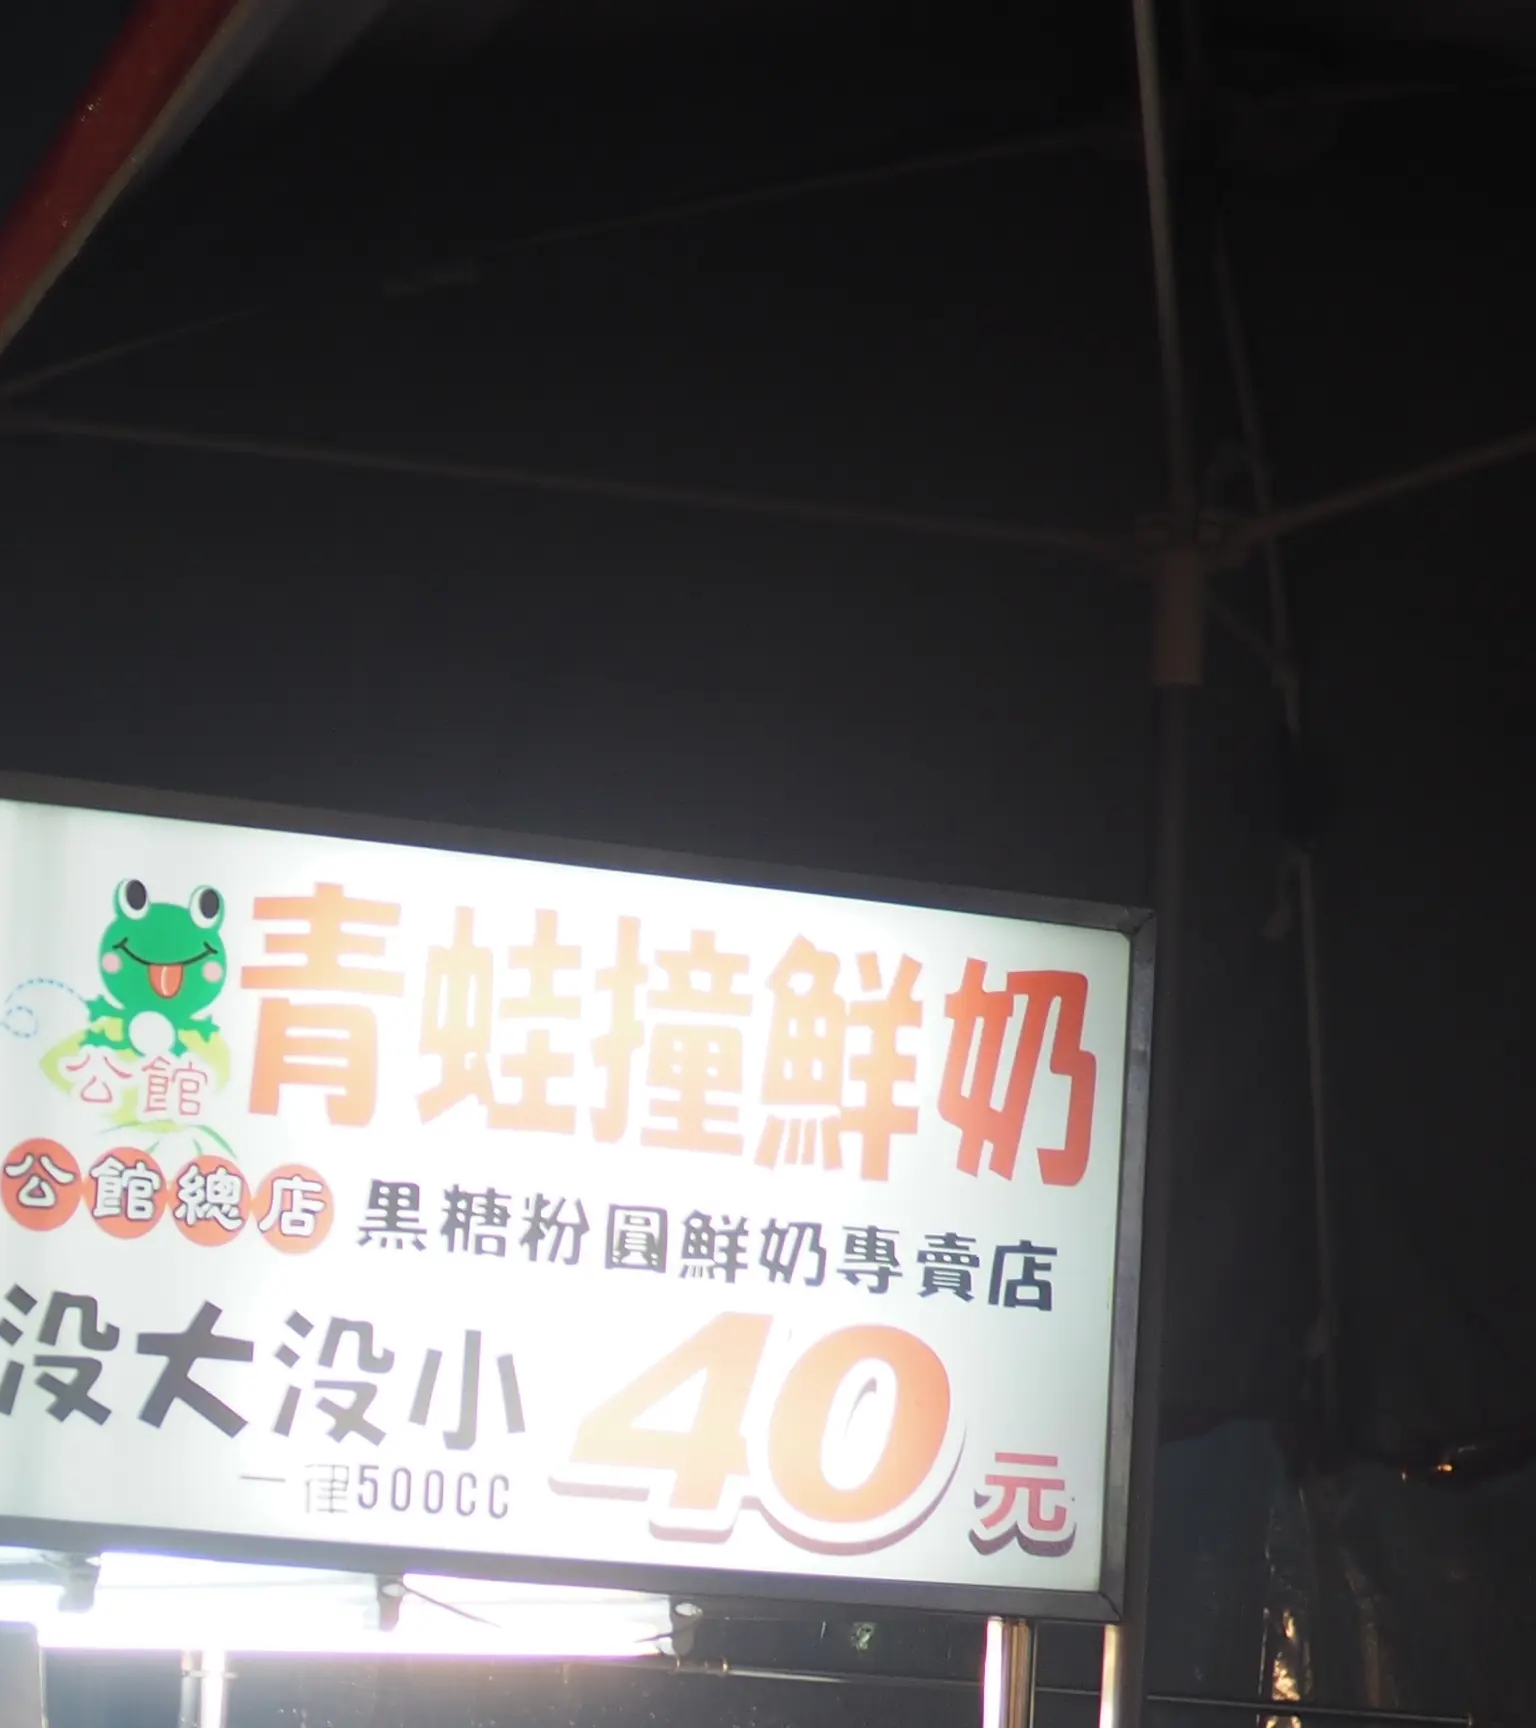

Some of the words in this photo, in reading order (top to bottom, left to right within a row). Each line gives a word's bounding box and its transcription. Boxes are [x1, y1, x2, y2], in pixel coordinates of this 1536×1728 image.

[63, 1050, 211, 1118] 公館
[240, 882, 1097, 1187] 青蛙撞鮮奶
[0, 1148, 326, 1246] 公館總店
[358, 1178, 1059, 1312] 黑糖粉圓鮮奶專賣店
[558, 1310, 960, 1545] 40
[976, 1450, 1075, 1555] 元
